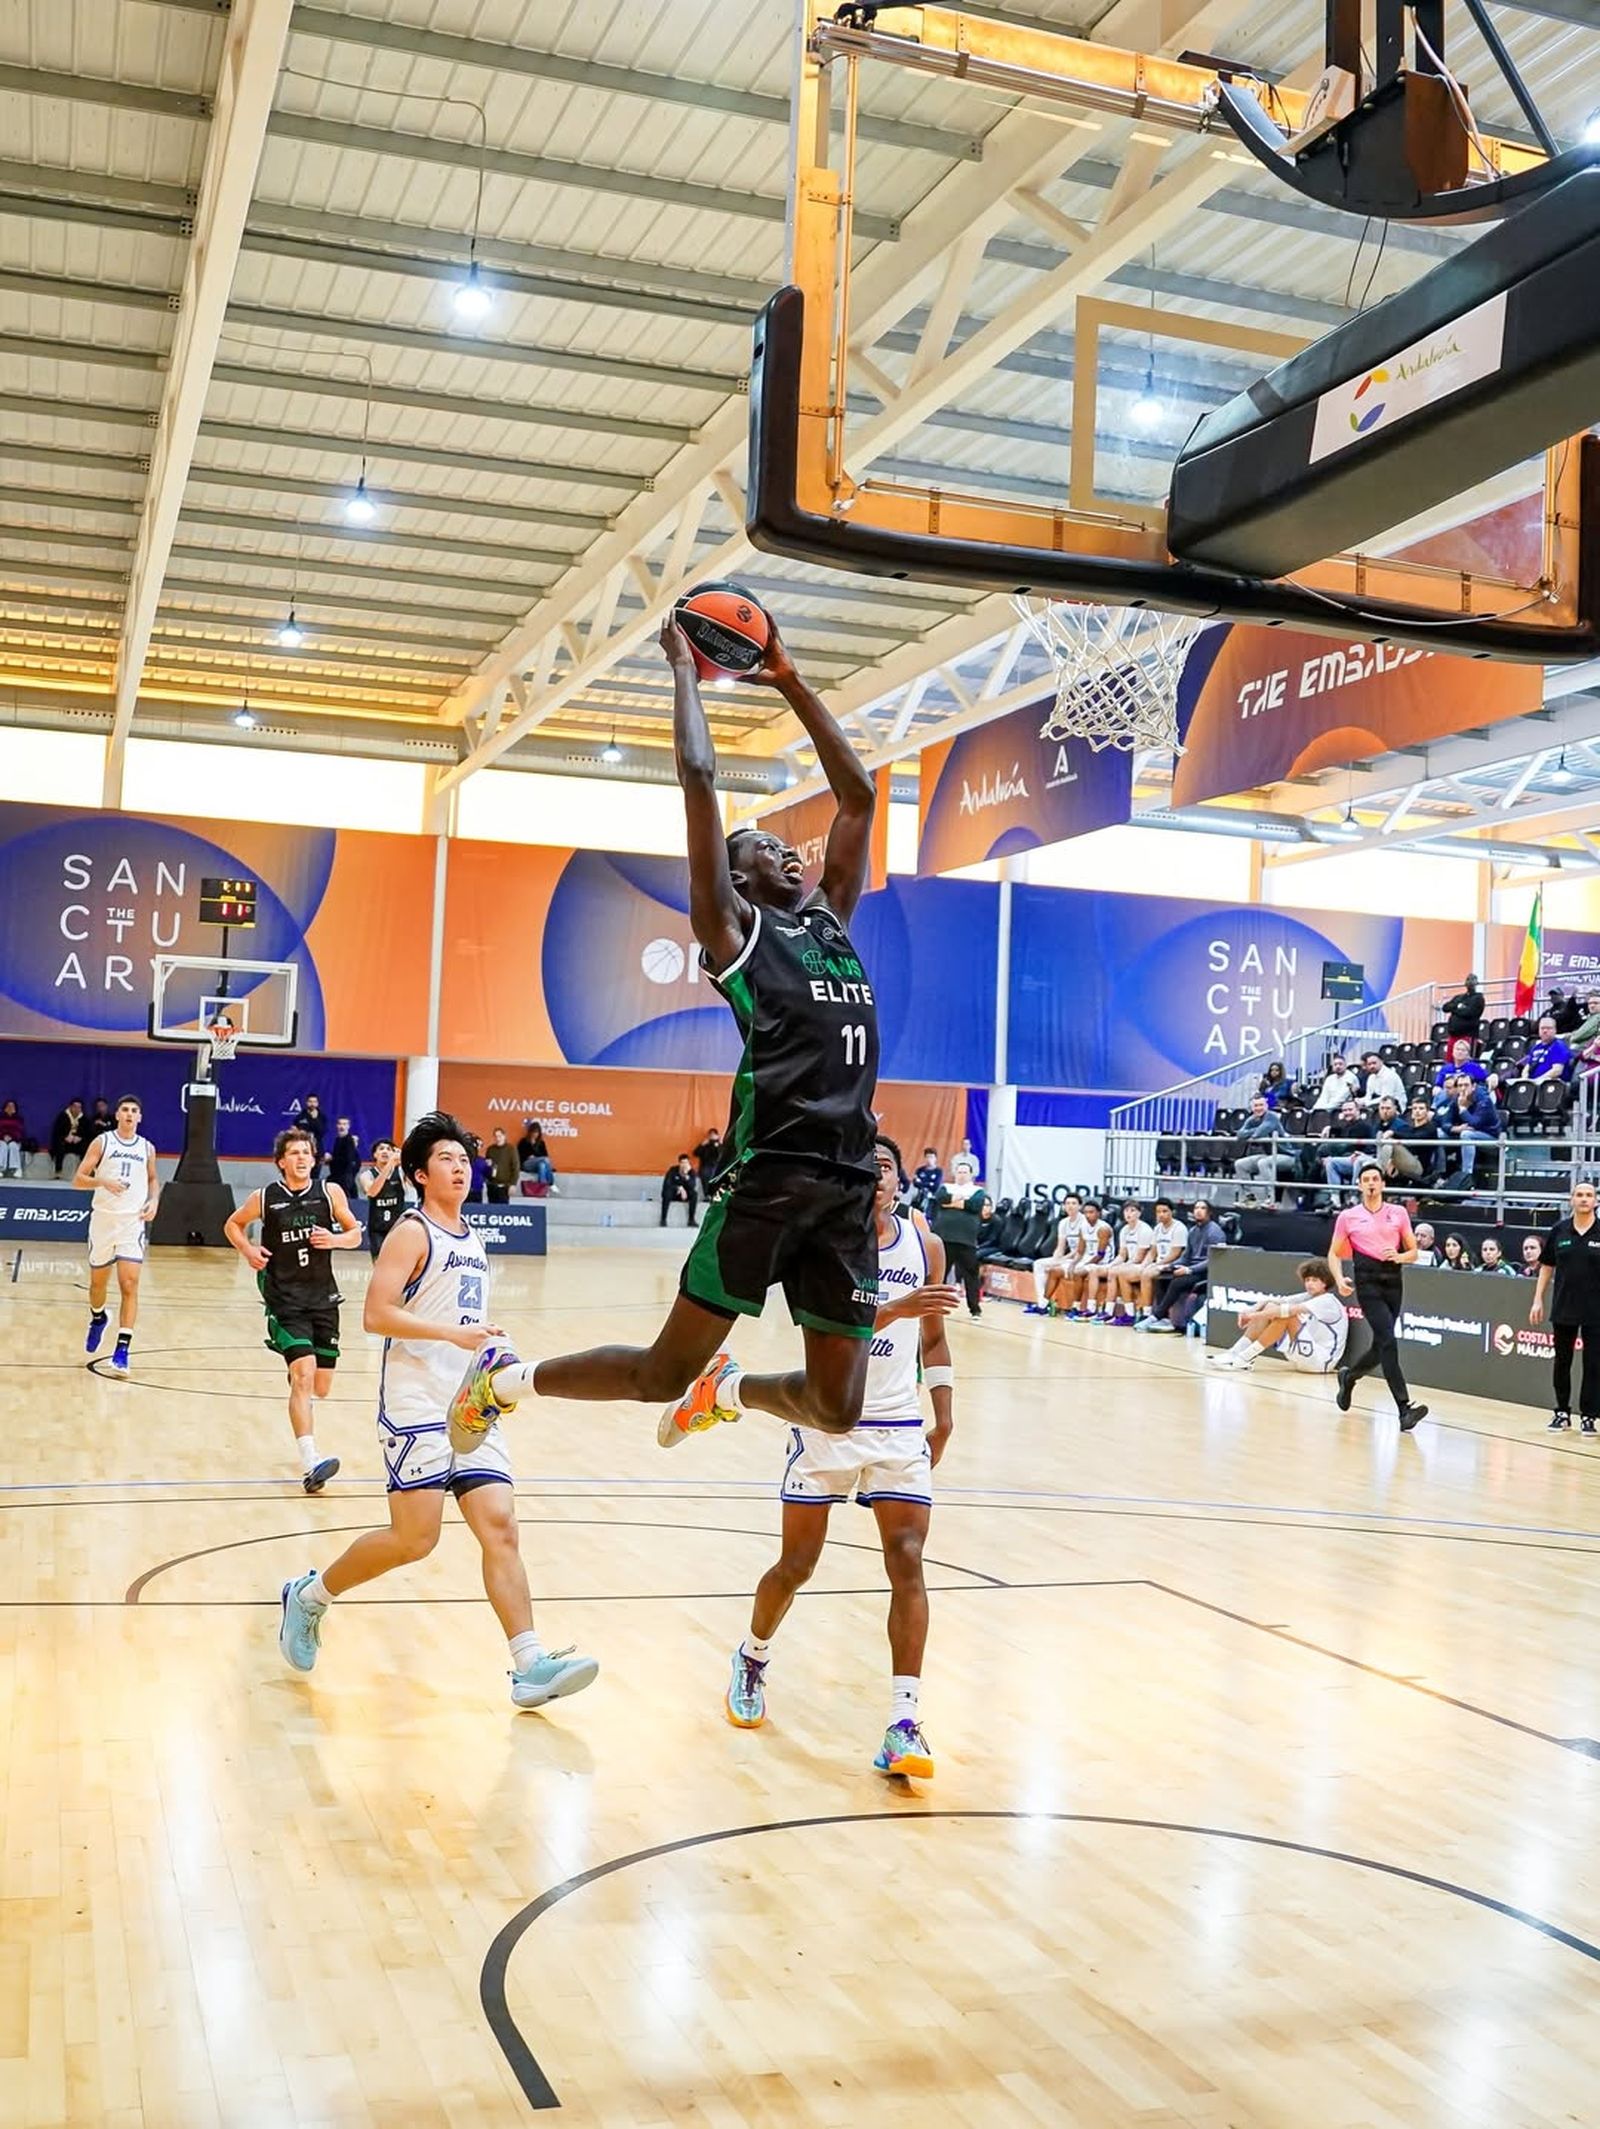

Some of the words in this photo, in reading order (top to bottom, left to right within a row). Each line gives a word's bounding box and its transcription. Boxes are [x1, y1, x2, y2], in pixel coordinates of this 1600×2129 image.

[1237, 669, 1288, 719] THE
[959, 762, 1029, 816] Andalucía
[62, 854, 186, 897] SAN
[106, 907, 135, 919] THE
[60, 904, 181, 947] CTU
[1208, 940, 1297, 976] SAN
[1569, 955, 1600, 969] EMB
[809, 980, 874, 1005] ELITE
[1240, 985, 1262, 995] THE
[1206, 983, 1294, 1019] CTU
[841, 1024, 866, 1065] 11
[1203, 1023, 1293, 1058] ARY
[488, 1098, 554, 1113] AVANCE
[558, 1101, 613, 1115] GLOBAL
[13, 1208, 90, 1222] EMBASSY
[462, 1214, 487, 1225] NCE
[488, 1215, 533, 1226] GLOBAL
[281, 1228, 315, 1243] ELIT
[298, 1248, 309, 1267] 5
[877, 1267, 918, 1289] ender
[869, 1337, 895, 1358] lite
[1518, 1330, 1548, 1345] COSTA
